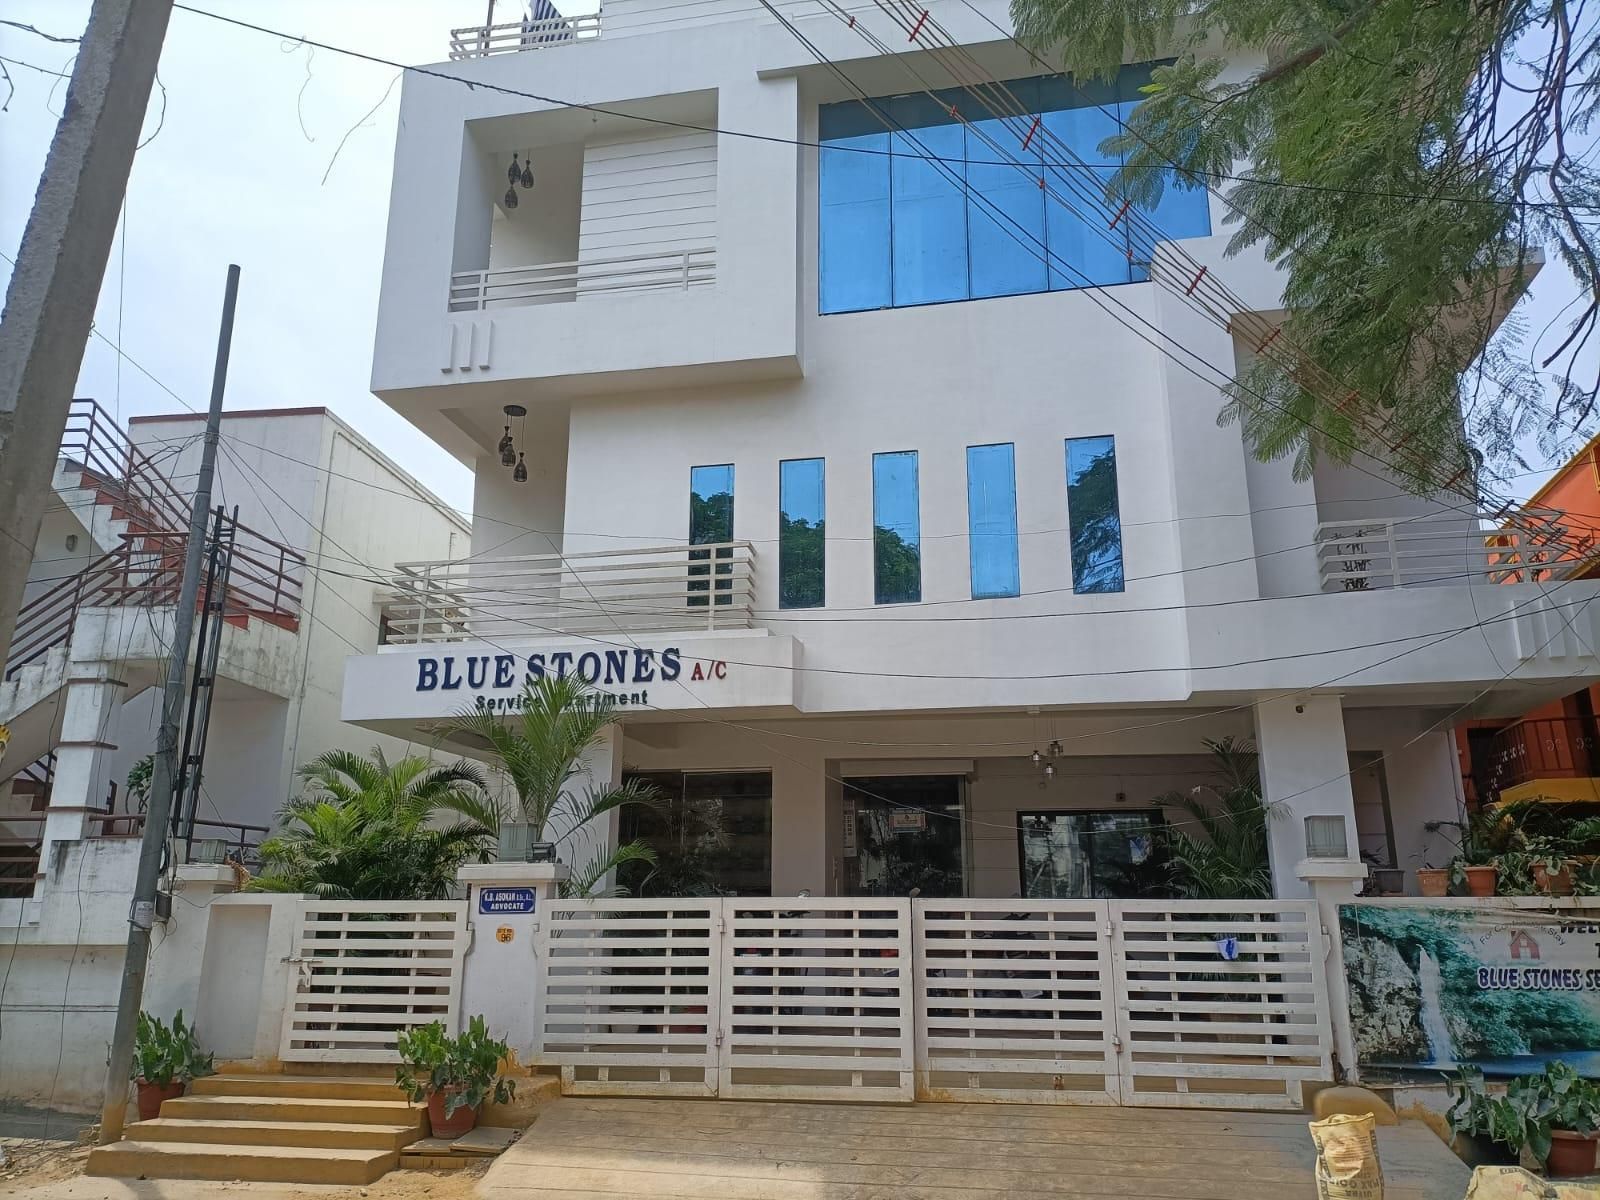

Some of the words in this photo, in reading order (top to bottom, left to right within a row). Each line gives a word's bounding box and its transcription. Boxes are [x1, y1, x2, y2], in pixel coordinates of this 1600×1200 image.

[416, 654, 515, 691] BLUE
[526, 647, 681, 686] STONES
[691, 659, 727, 681] A/C
[490, 902, 524, 910] ADVOCATE
[501, 934, 511, 942] 96
[1479, 930, 1493, 945] For
[1547, 928, 1566, 946] Stay
[1478, 967, 1519, 988] BLUE
[1522, 968, 1581, 988] STONES
